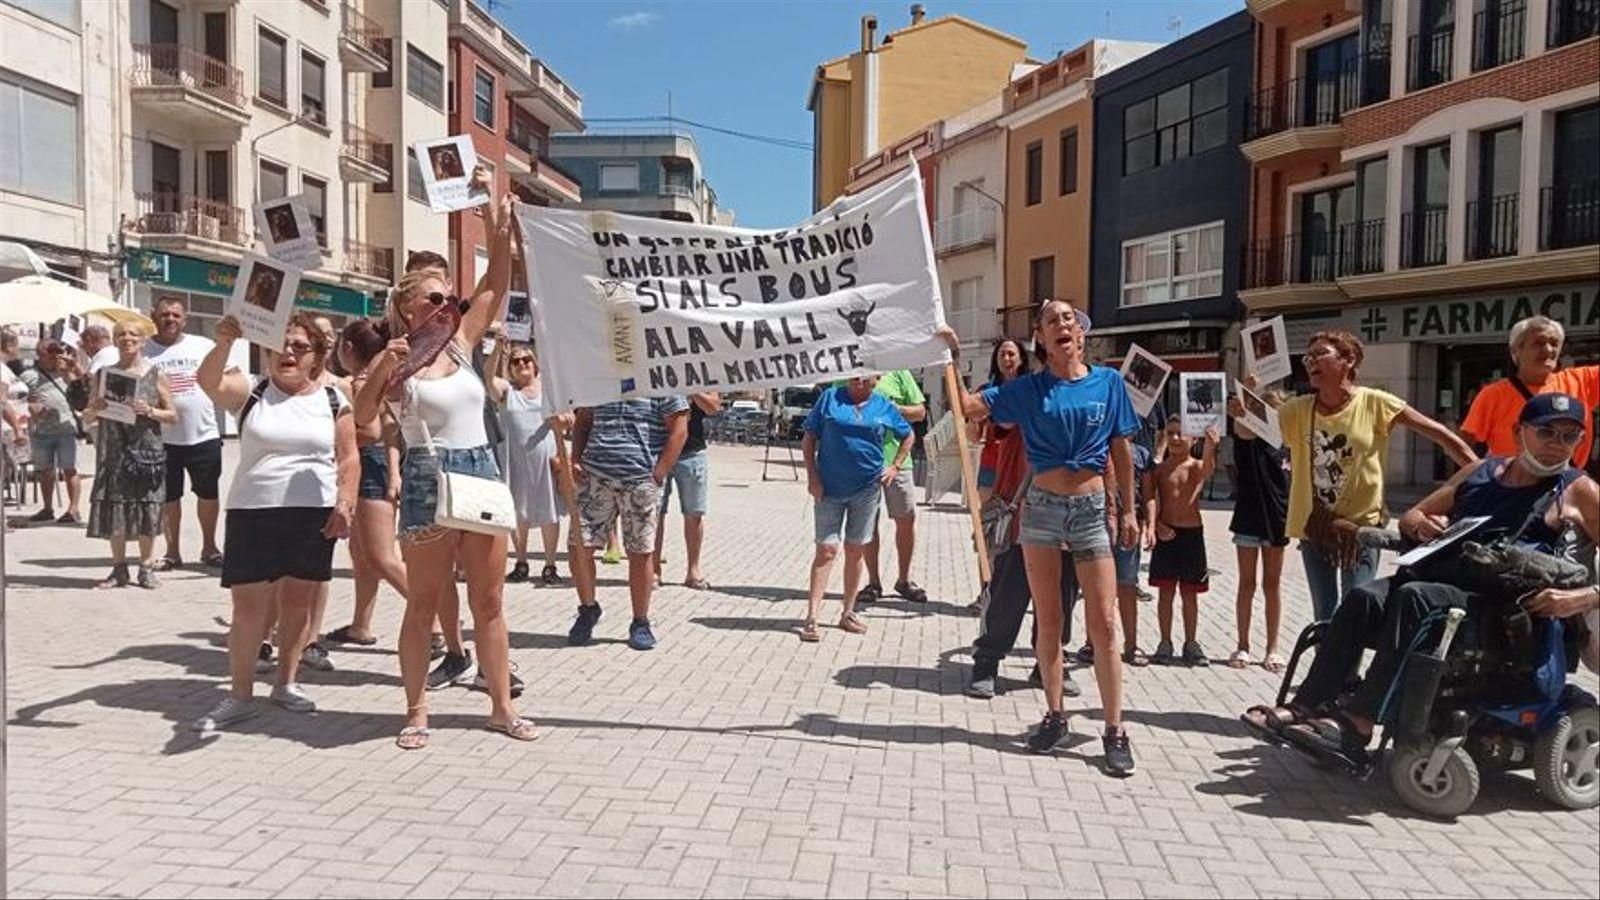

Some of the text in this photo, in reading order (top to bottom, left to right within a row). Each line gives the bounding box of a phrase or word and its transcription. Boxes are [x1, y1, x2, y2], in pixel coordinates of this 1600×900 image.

[606, 253, 712, 278] CAMBIAR
[717, 245, 769, 274] UNA
[773, 213, 873, 265] TRADICIÓ
[679, 277, 742, 310] ALS
[758, 257, 857, 304] BOUS
[613, 312, 633, 364] AVANT
[720, 312, 827, 349] VALL
[648, 344, 864, 390] NO AL MALTRACTE
